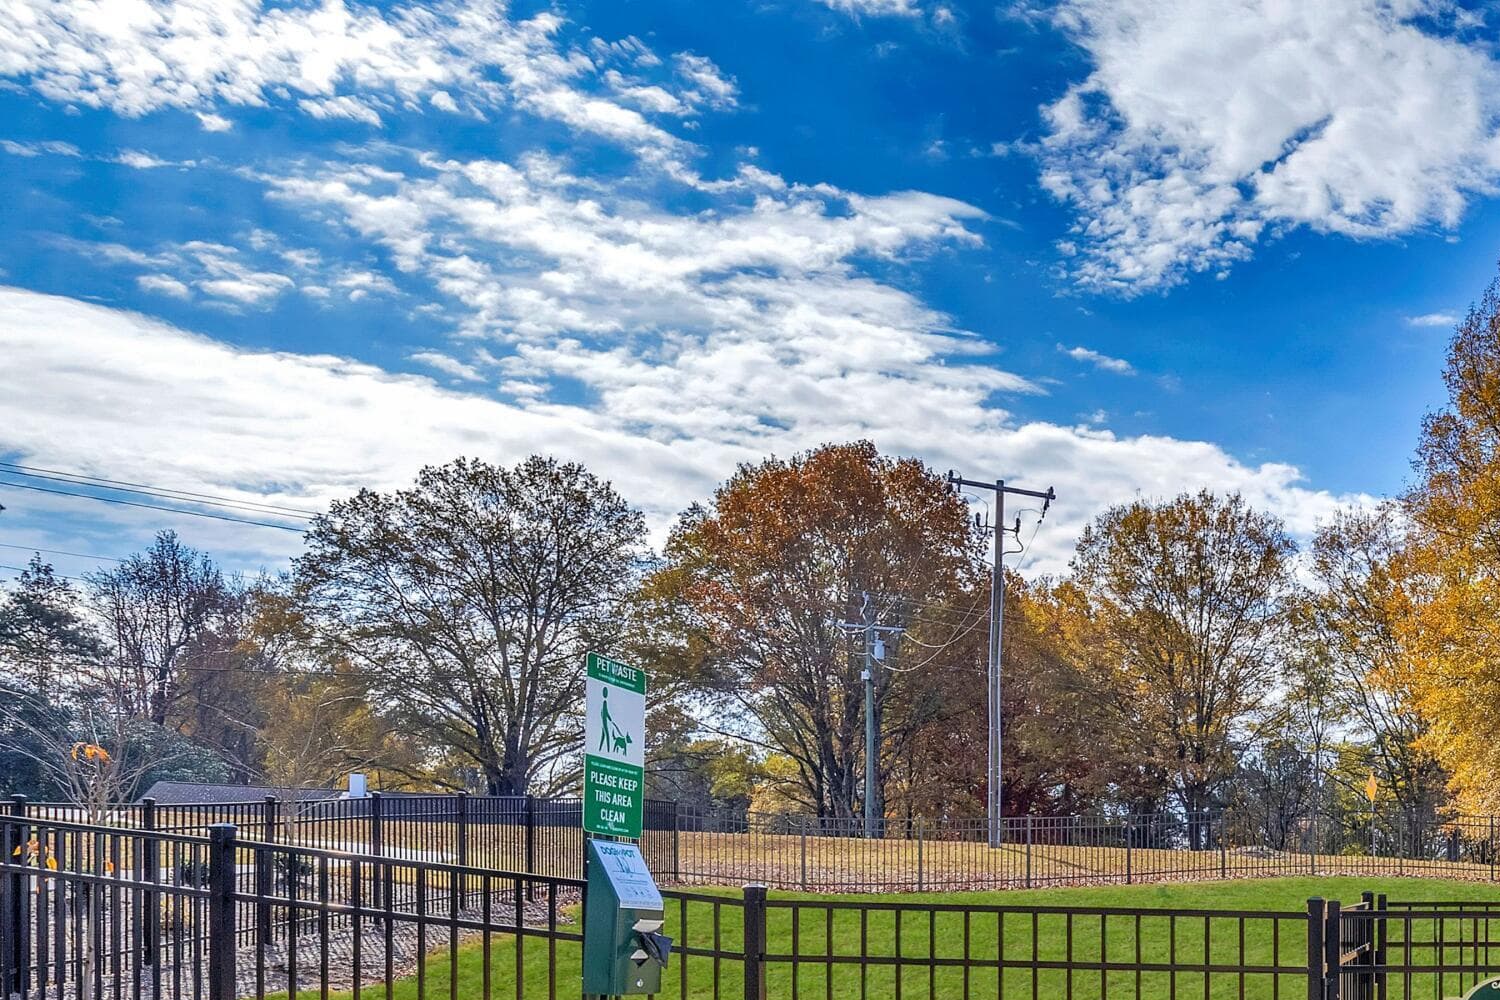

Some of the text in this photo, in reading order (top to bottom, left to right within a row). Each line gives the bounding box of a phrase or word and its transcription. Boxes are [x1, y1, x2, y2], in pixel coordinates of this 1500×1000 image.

[597, 657, 610, 672] PET
[611, 662, 637, 682] WASTE
[590, 771, 638, 792] PLEASE KEEP
[594, 790, 632, 808] THIS AREA
[600, 809, 625, 824] CLEAN
